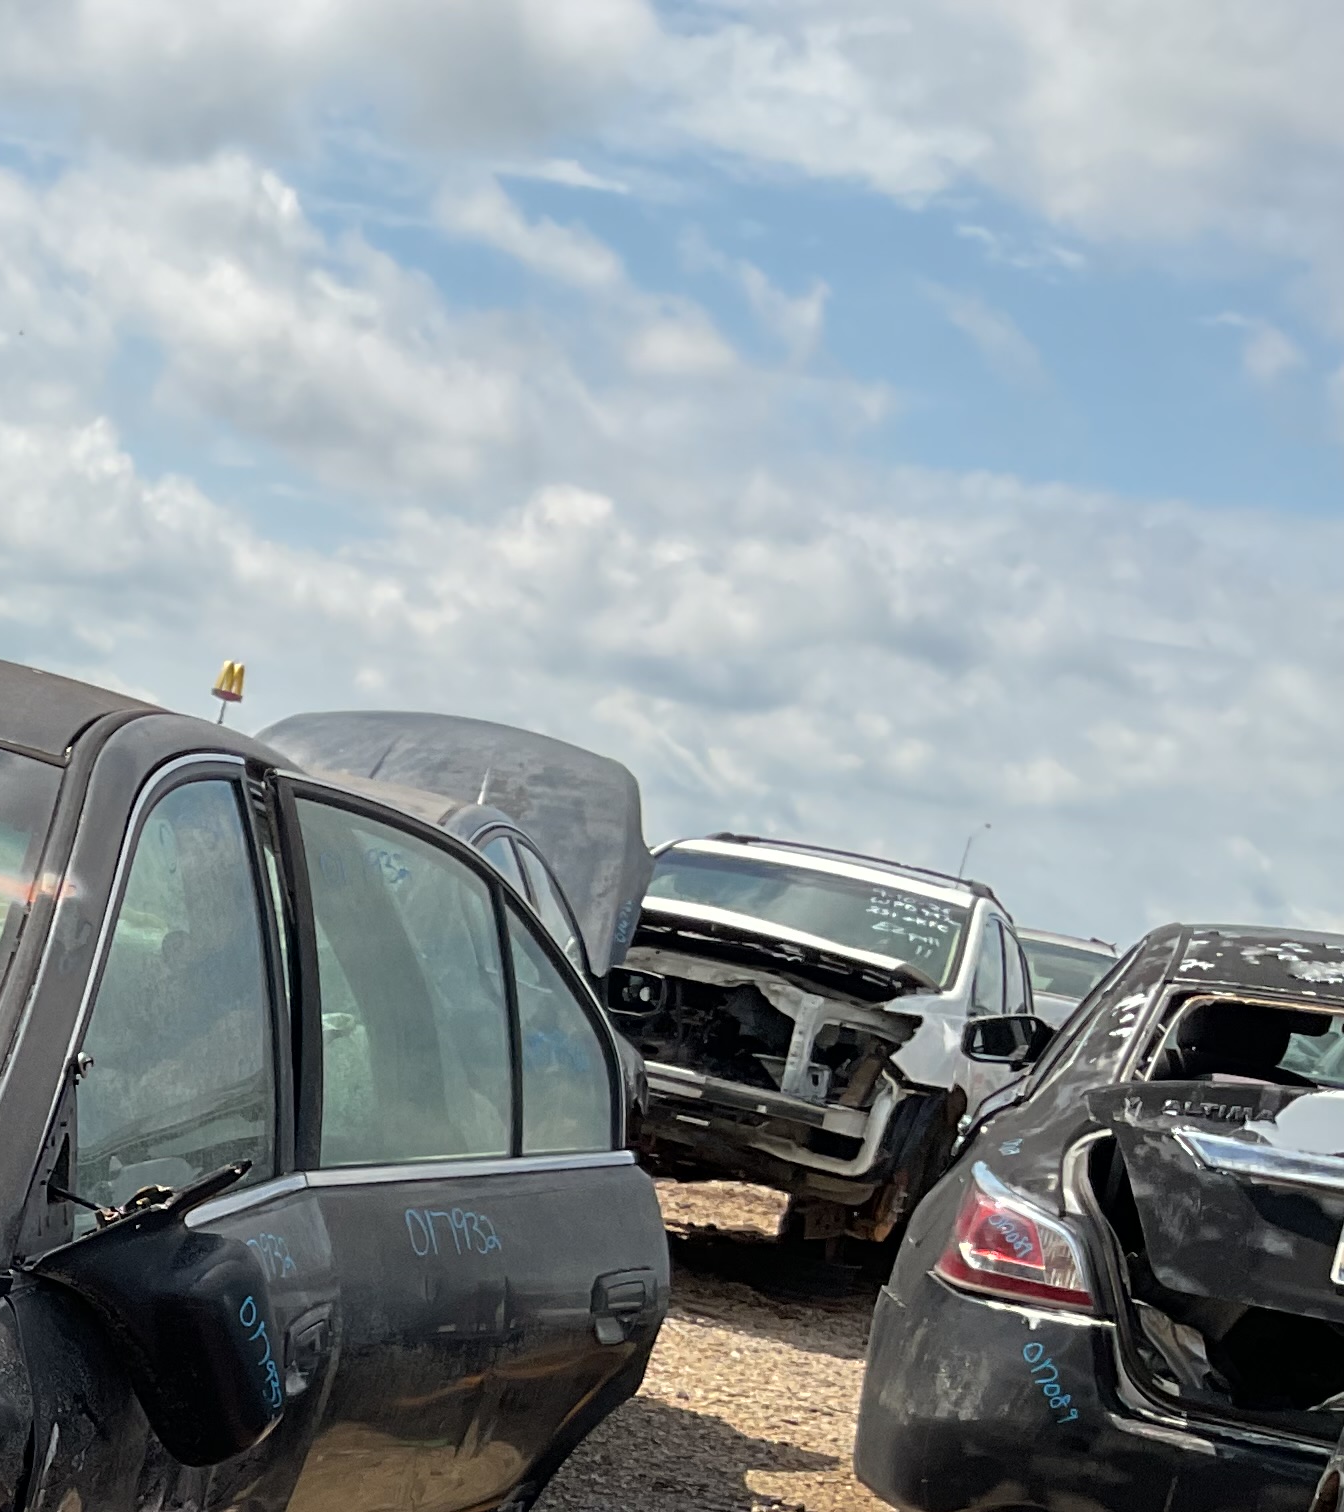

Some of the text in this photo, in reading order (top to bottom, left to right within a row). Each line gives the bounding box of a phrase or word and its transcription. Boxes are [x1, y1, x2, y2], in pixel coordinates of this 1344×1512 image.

[1162, 1099, 1276, 1122] ALTIMA
[405, 1207, 502, 1256] 017932
[1023, 1342, 1079, 1424] 017089
